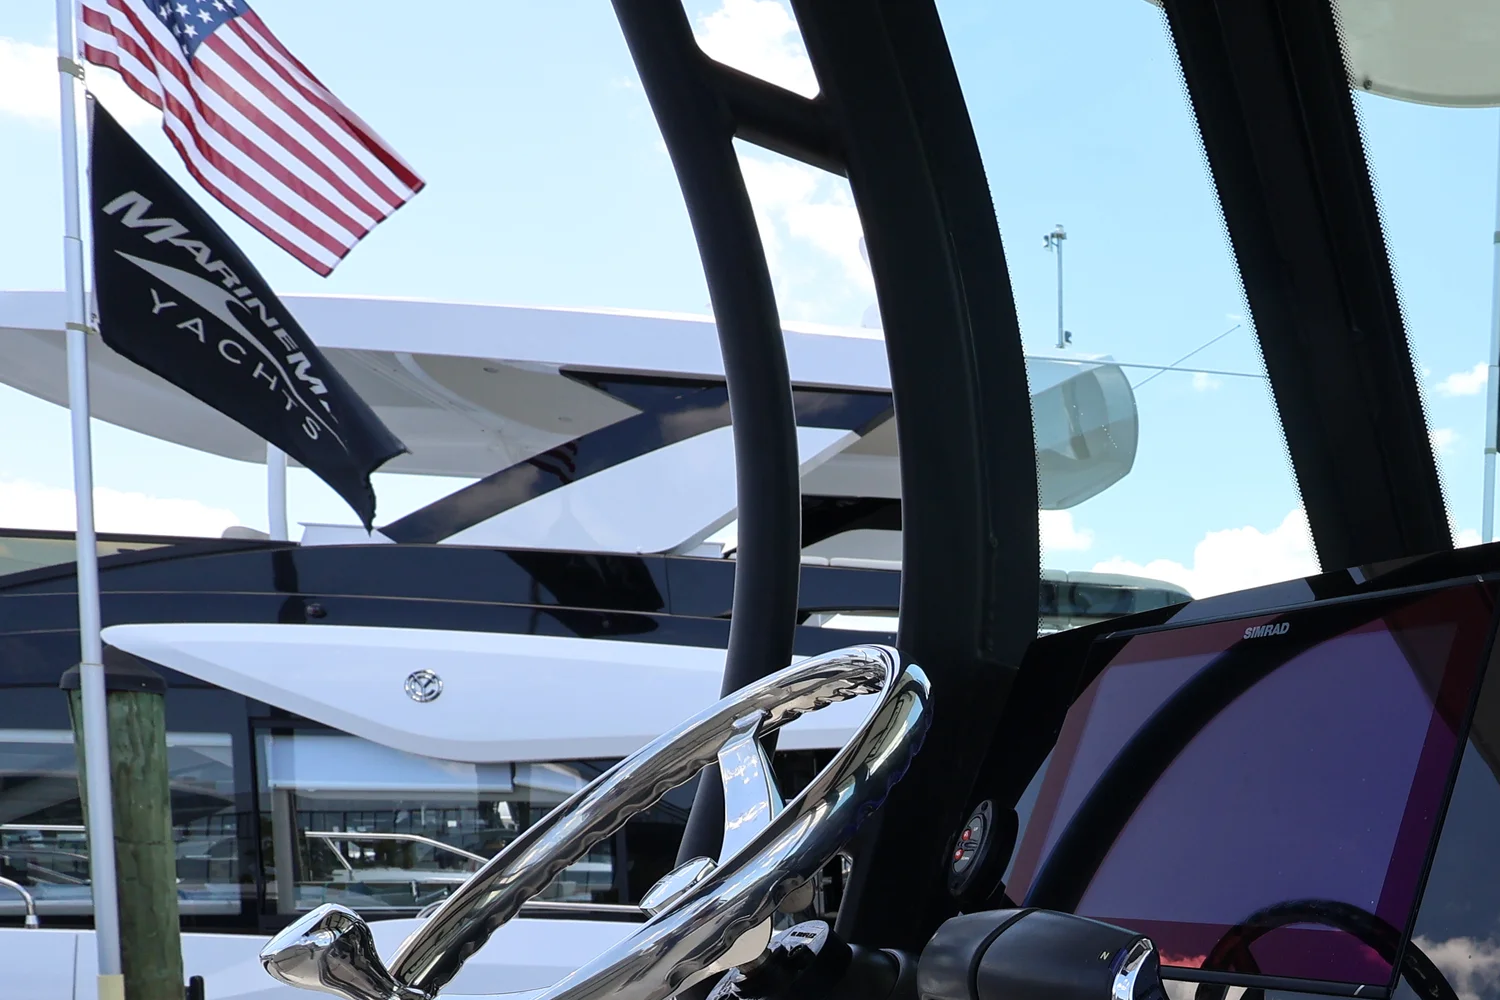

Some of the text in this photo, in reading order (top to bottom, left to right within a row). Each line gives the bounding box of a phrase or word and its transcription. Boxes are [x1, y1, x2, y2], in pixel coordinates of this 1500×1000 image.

[149, 288, 321, 440] YACHTS
[1243, 622, 1290, 640] SIMRAD
[1099, 951, 1110, 960] N
